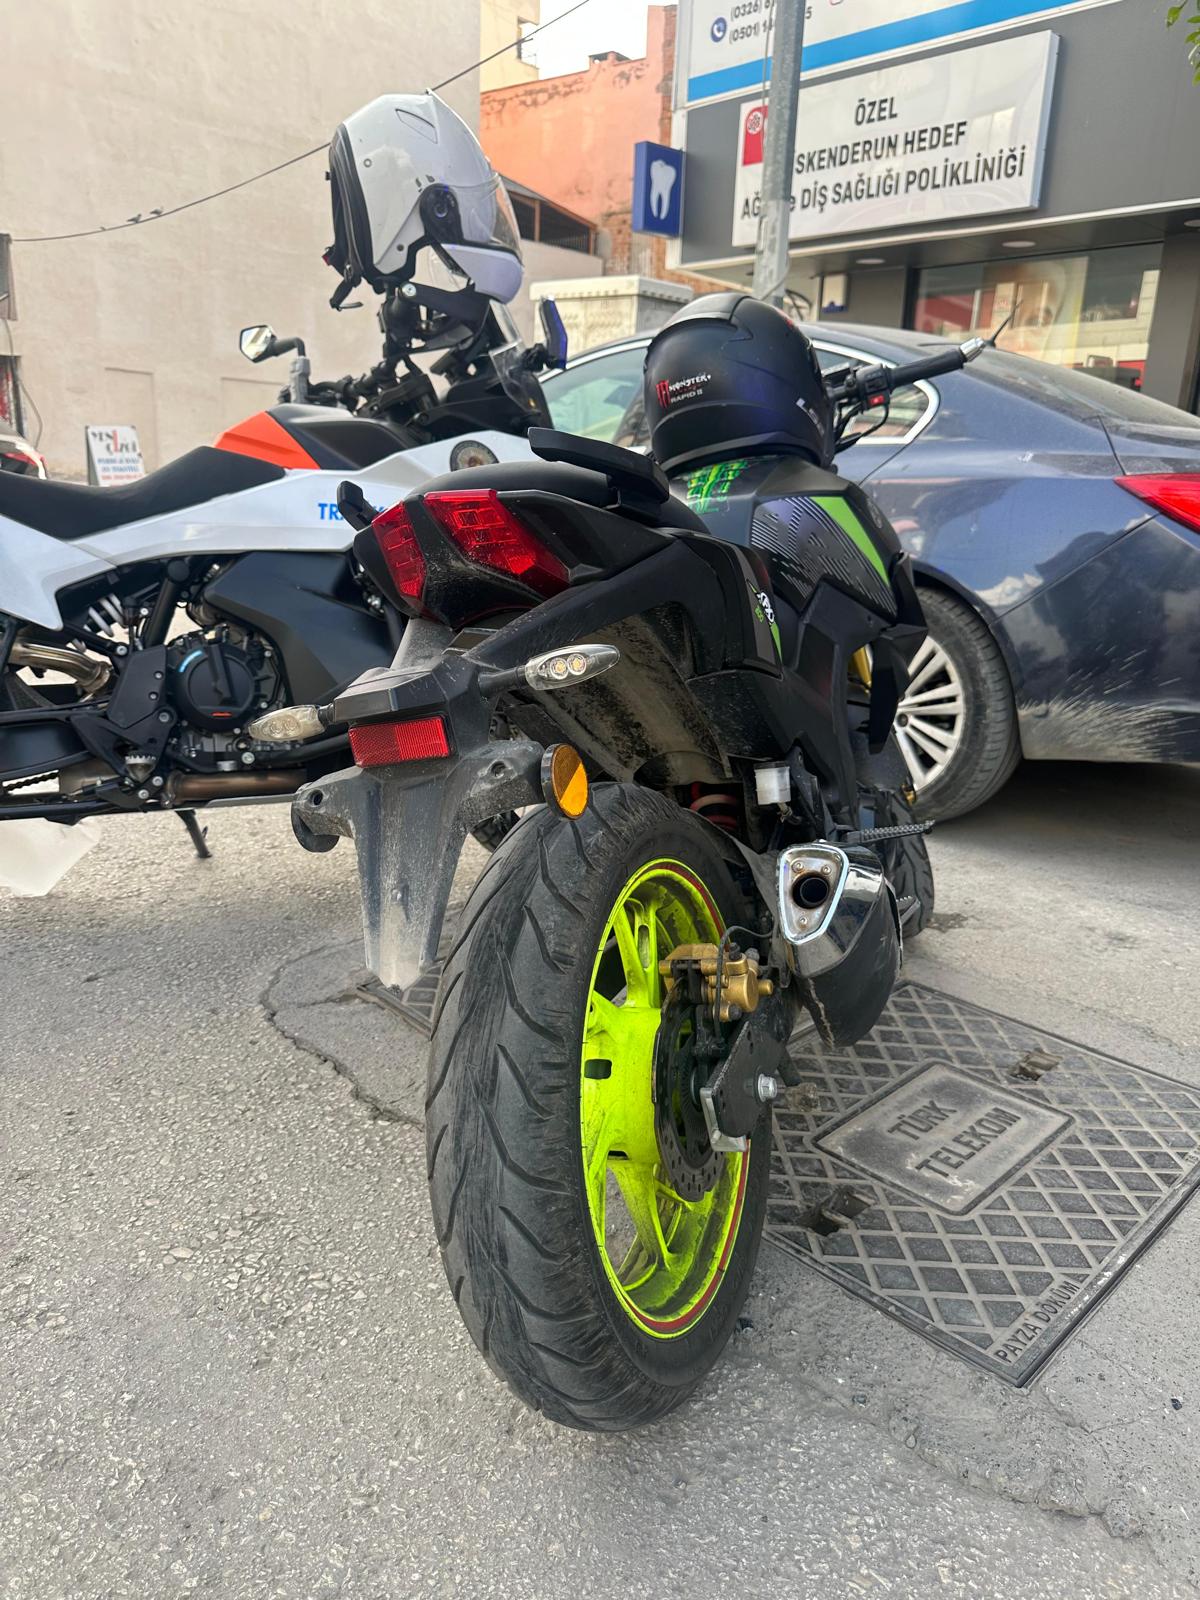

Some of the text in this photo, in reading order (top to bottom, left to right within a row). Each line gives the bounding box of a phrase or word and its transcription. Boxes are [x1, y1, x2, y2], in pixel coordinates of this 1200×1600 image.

[855, 97, 898, 126] ÖZEL
[795, 121, 967, 174] SKENDERUN HEDEF
[801, 180, 828, 215] DİŞ
[832, 165, 900, 204] SAĞLIĞI
[905, 145, 1026, 194] POLİKLİNİĞİ
[888, 1100, 957, 1140] TÜRK
[915, 1107, 1021, 1178] TELEKOM
[994, 1281, 1080, 1363] PAYZA DÖKÜM
